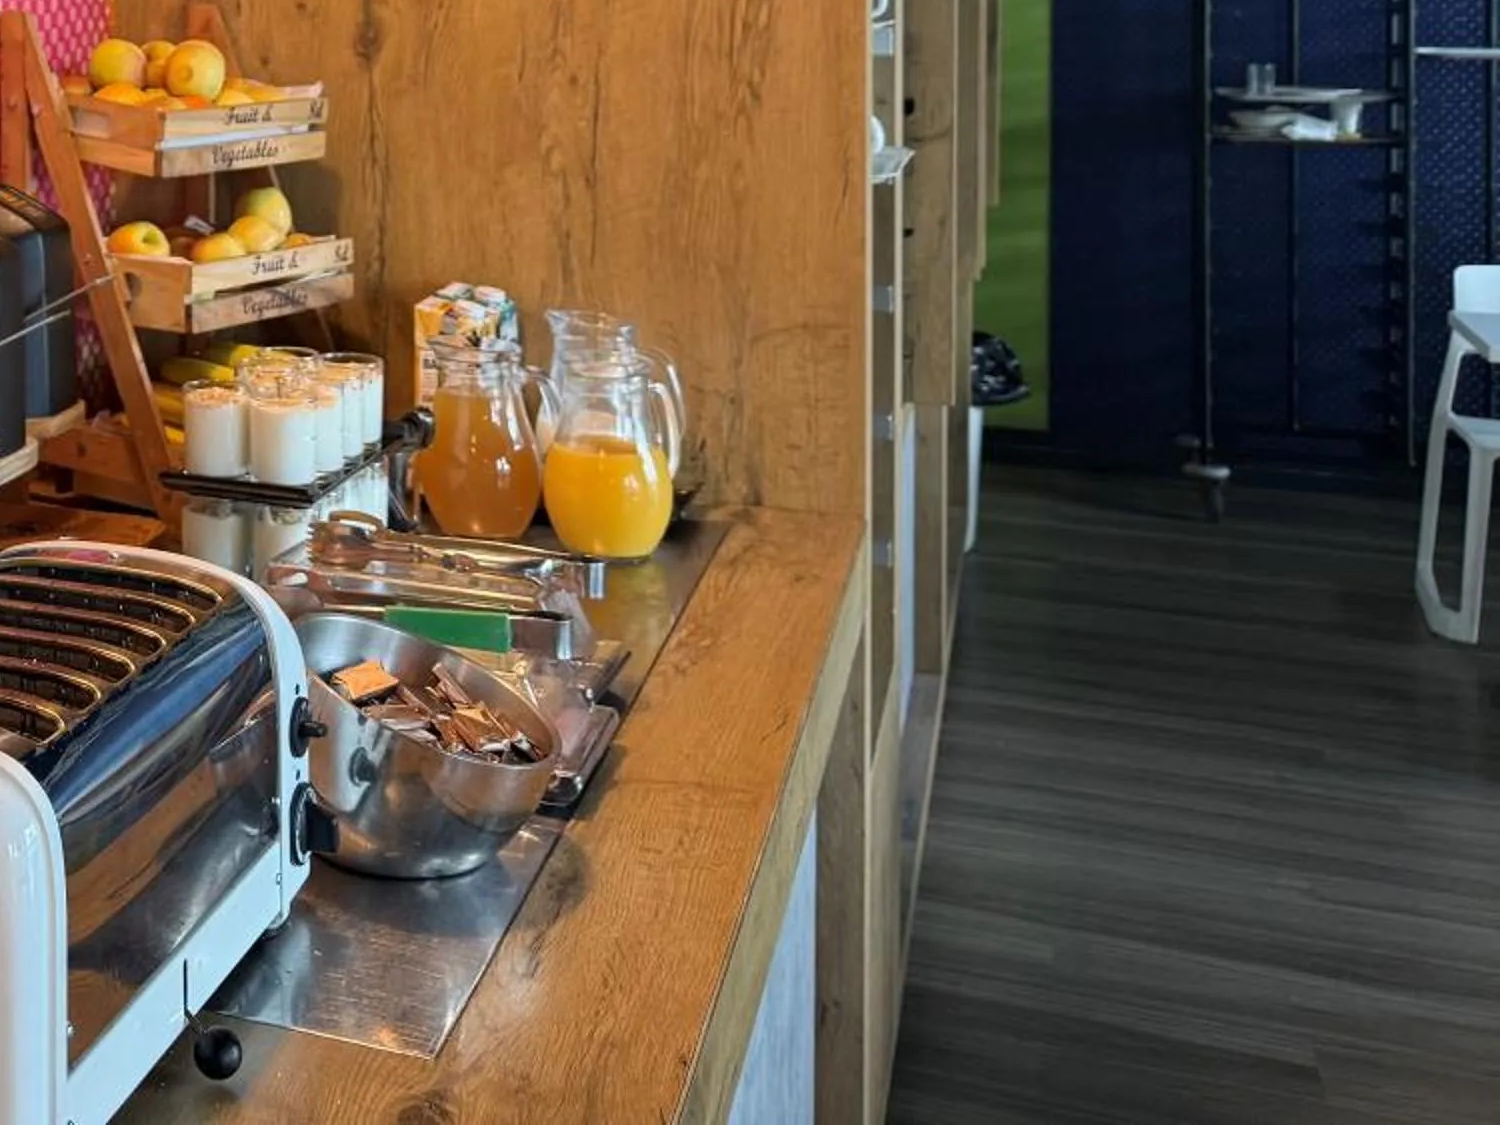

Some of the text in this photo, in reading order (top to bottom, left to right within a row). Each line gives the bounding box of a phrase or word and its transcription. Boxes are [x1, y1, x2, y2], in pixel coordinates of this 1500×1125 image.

[224, 106, 258, 125] Fruit
[212, 140, 279, 167] Vegetables
[251, 256, 284, 275] Fruit
